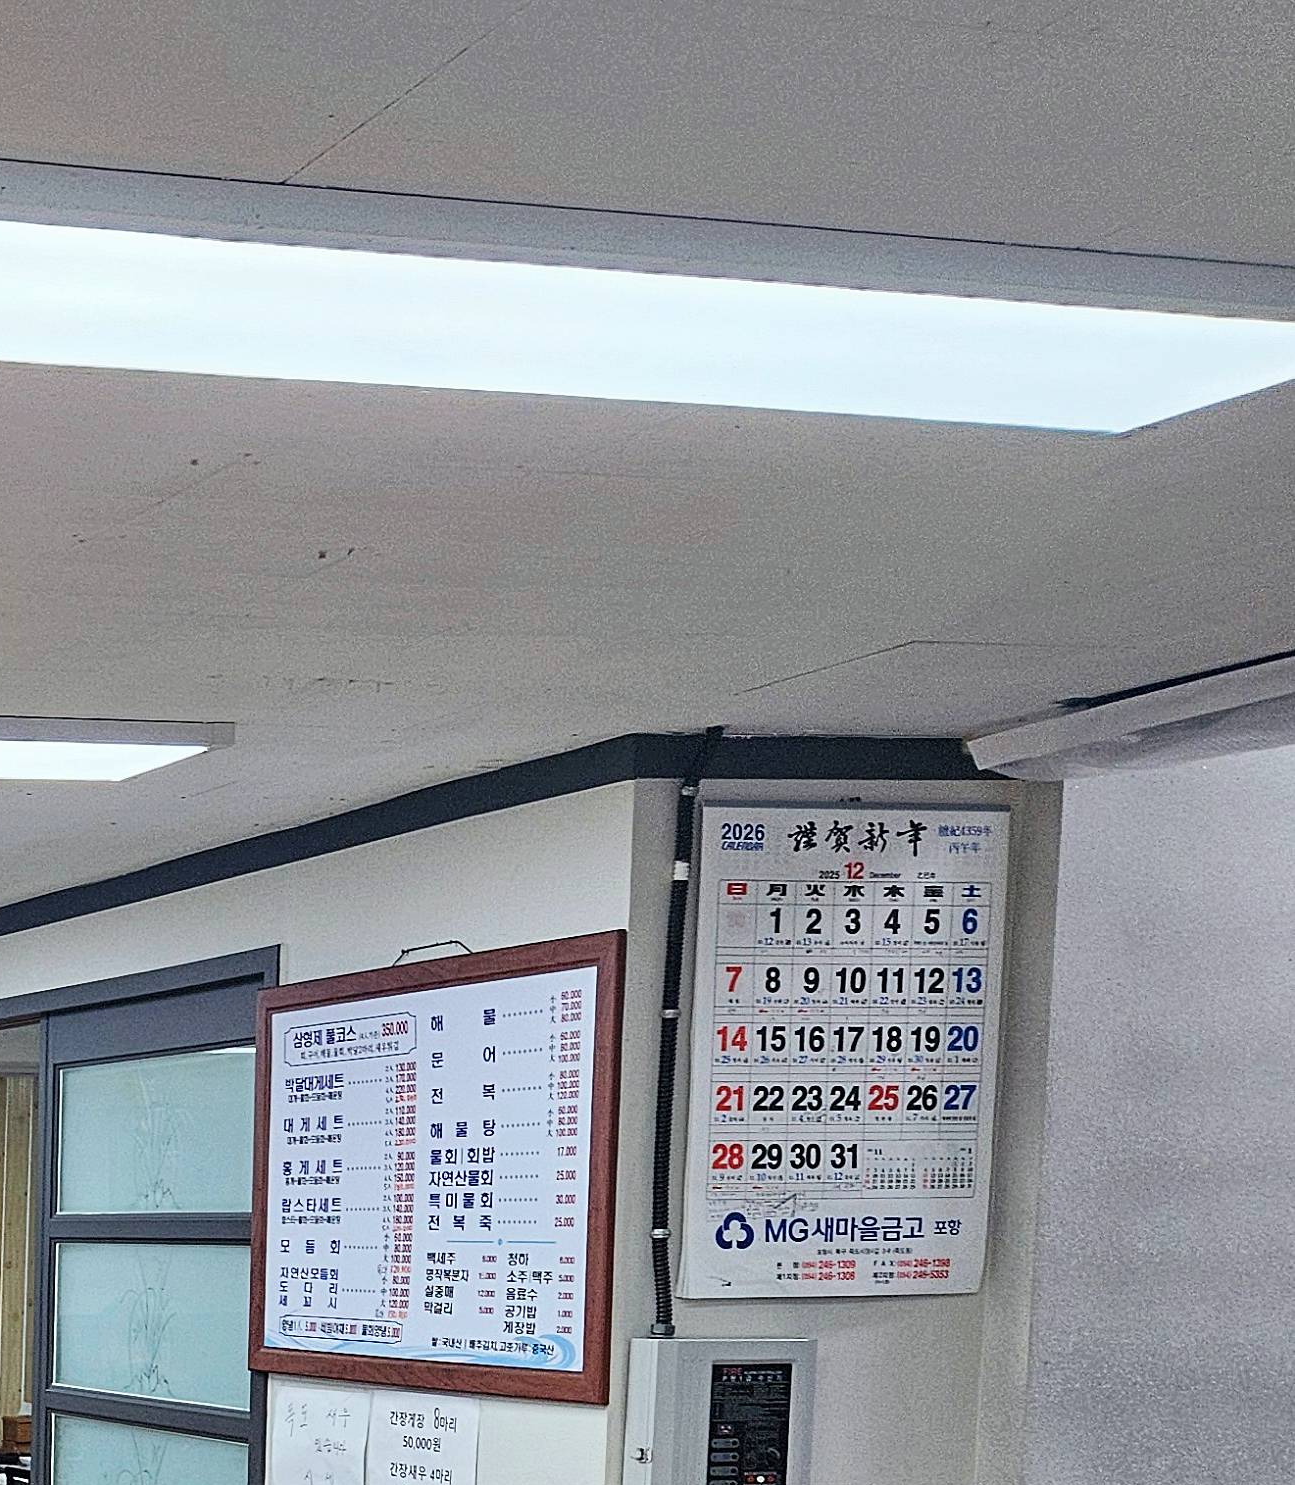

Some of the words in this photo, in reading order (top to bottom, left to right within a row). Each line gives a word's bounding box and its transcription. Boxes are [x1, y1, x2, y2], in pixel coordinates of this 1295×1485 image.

[721, 823, 765, 842] 2026
[787, 819, 928, 857] 謹賀新年
[721, 841, 764, 851] CALENDAR
[818, 870, 840, 880] 2025
[844, 862, 865, 880] 12
[869, 871, 901, 879] December
[727, 883, 748, 895] 日
[766, 884, 788, 896] 月
[804, 884, 826, 896] 火
[961, 885, 981, 898] 土
[770, 907, 781, 934] 1
[805, 908, 822, 934] 2
[844, 908, 861, 935] 3
[884, 908, 901, 935] 4
[923, 908, 940, 935] 5
[962, 908, 978, 935] 6
[726, 966, 742, 992] 7
[765, 966, 781, 993] 8
[803, 966, 820, 993] 9
[835, 966, 866, 993] 10
[877, 967, 904, 993] 11
[914, 966, 945, 993] 12
[952, 966, 982, 993] 13
[293, 1030, 322, 1049] 삼형제
[326, 1025, 357, 1045] 풀코스
[716, 1026, 748, 1051] 14
[756, 1026, 786, 1052] 15
[794, 1026, 825, 1052] 16
[833, 1026, 865, 1052] 17
[872, 1026, 902, 1052] 18
[911, 1026, 940, 1052] 19
[947, 1026, 979, 1051] 20
[285, 1073, 344, 1093] 박달대게세트
[716, 1085, 744, 1111] 21
[753, 1085, 784, 1111] 22
[791, 1085, 823, 1111] 23
[829, 1085, 861, 1111] 24
[867, 1084, 900, 1110] 25
[906, 1084, 938, 1111] 26
[943, 1084, 977, 1110] 27
[712, 1143, 744, 1169] 28
[751, 1143, 783, 1170] 29
[790, 1143, 821, 1169] 30
[830, 1143, 858, 1169] 31
[428, 1169, 493, 1187] 자연산물회
[933, 1219, 963, 1236] 포항
[427, 1252, 456, 1265] 백세주
[508, 1253, 529, 1266] 청하
[506, 1287, 538, 1301] 음료수
[424, 1302, 453, 1315] 막걸리
[505, 1305, 537, 1319] 공기밥
[503, 1321, 536, 1335] 게장밥
[389, 1410, 425, 1429] 간장게장
[433, 1407, 458, 1433] 8마리
[403, 1435, 441, 1453] 50,000원
[389, 1462, 426, 1481] 간장새우
[429, 1468, 453, 1485] 4마리
